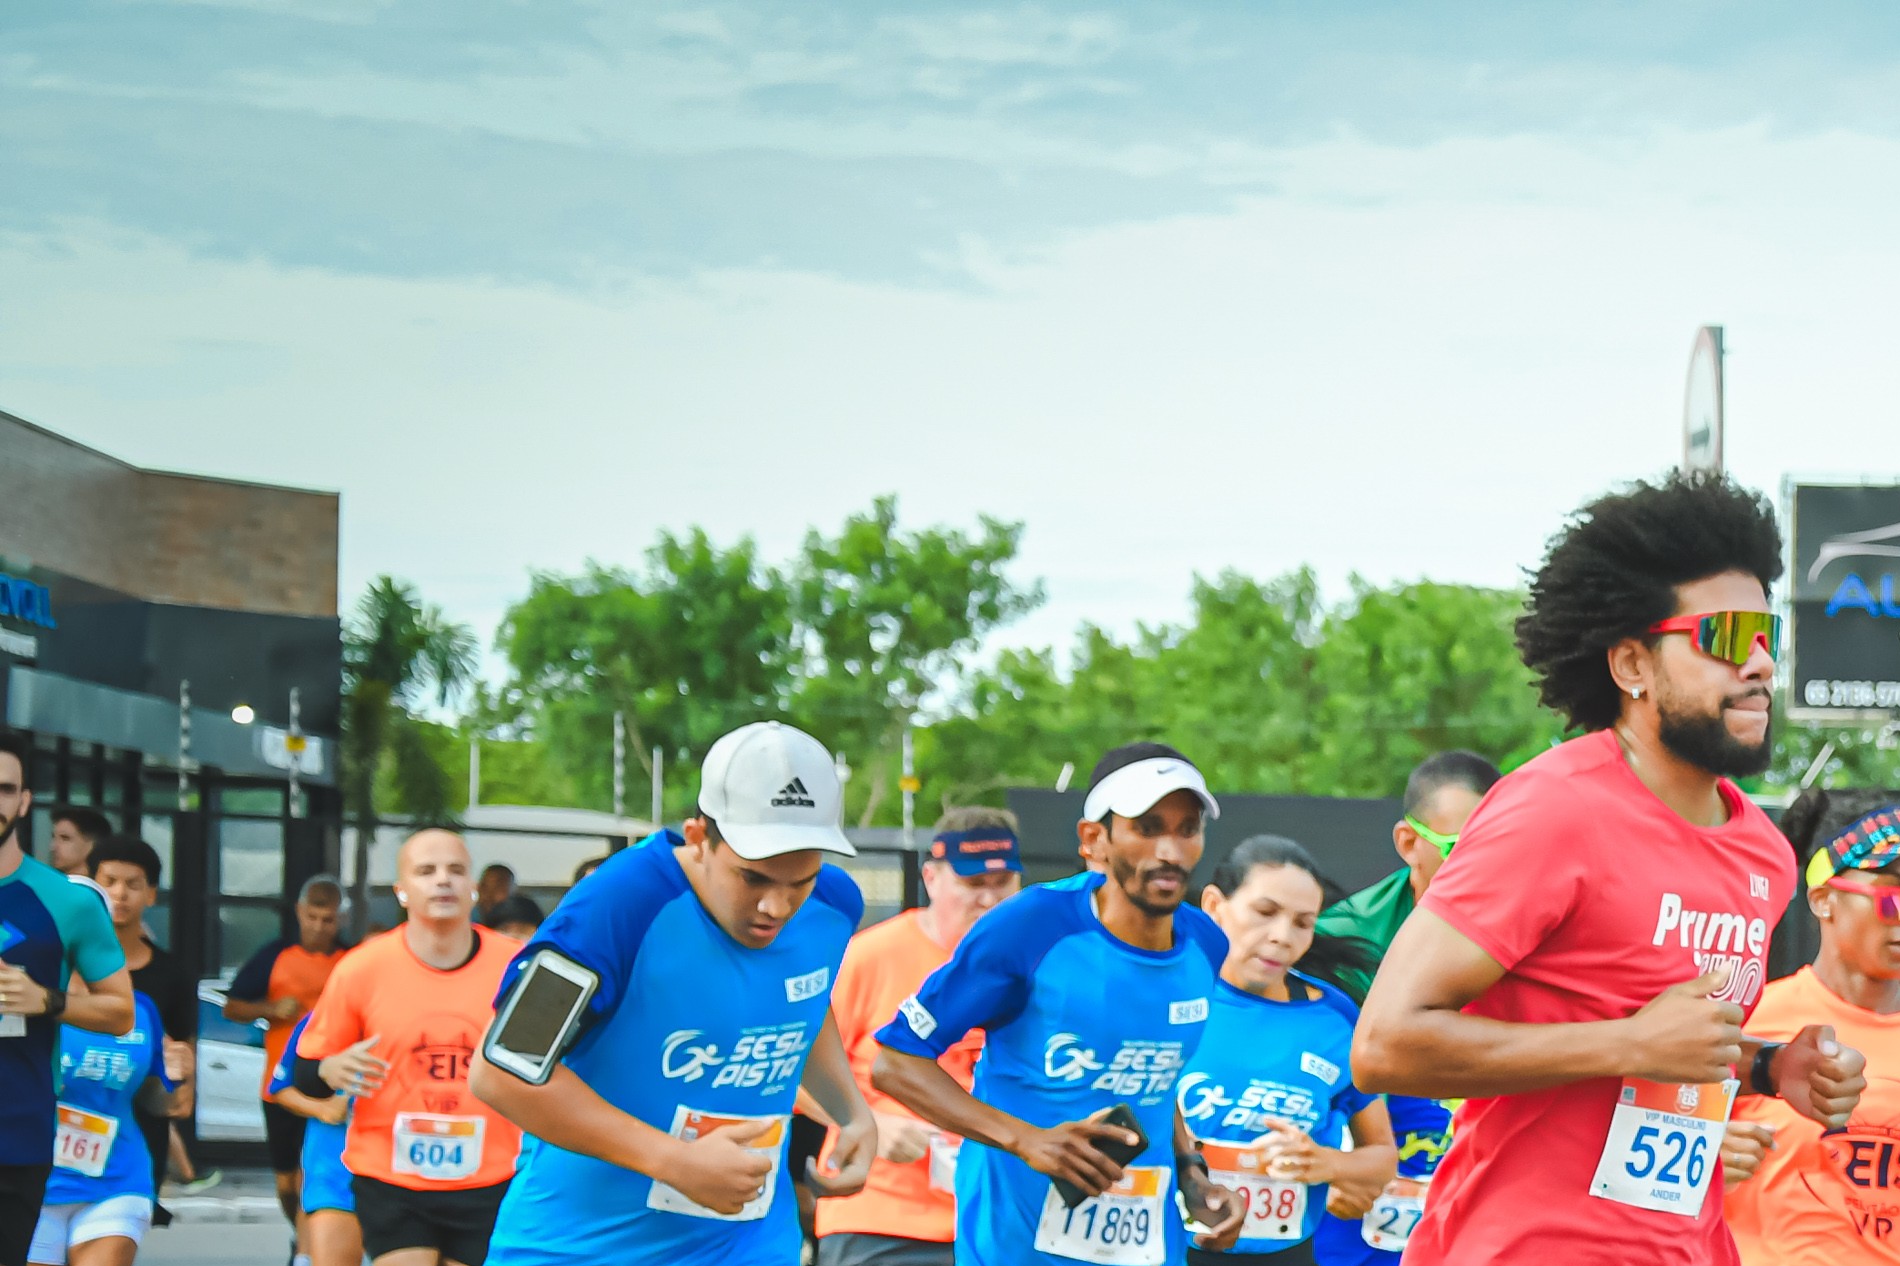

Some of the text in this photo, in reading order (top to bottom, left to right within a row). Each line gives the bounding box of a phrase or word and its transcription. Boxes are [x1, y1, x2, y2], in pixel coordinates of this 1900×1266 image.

[1652, 892, 1766, 964] Prime
[711, 1055, 801, 1089] PISTA
[409, 1140, 463, 1166] 604
[1625, 1125, 1707, 1188] 526
